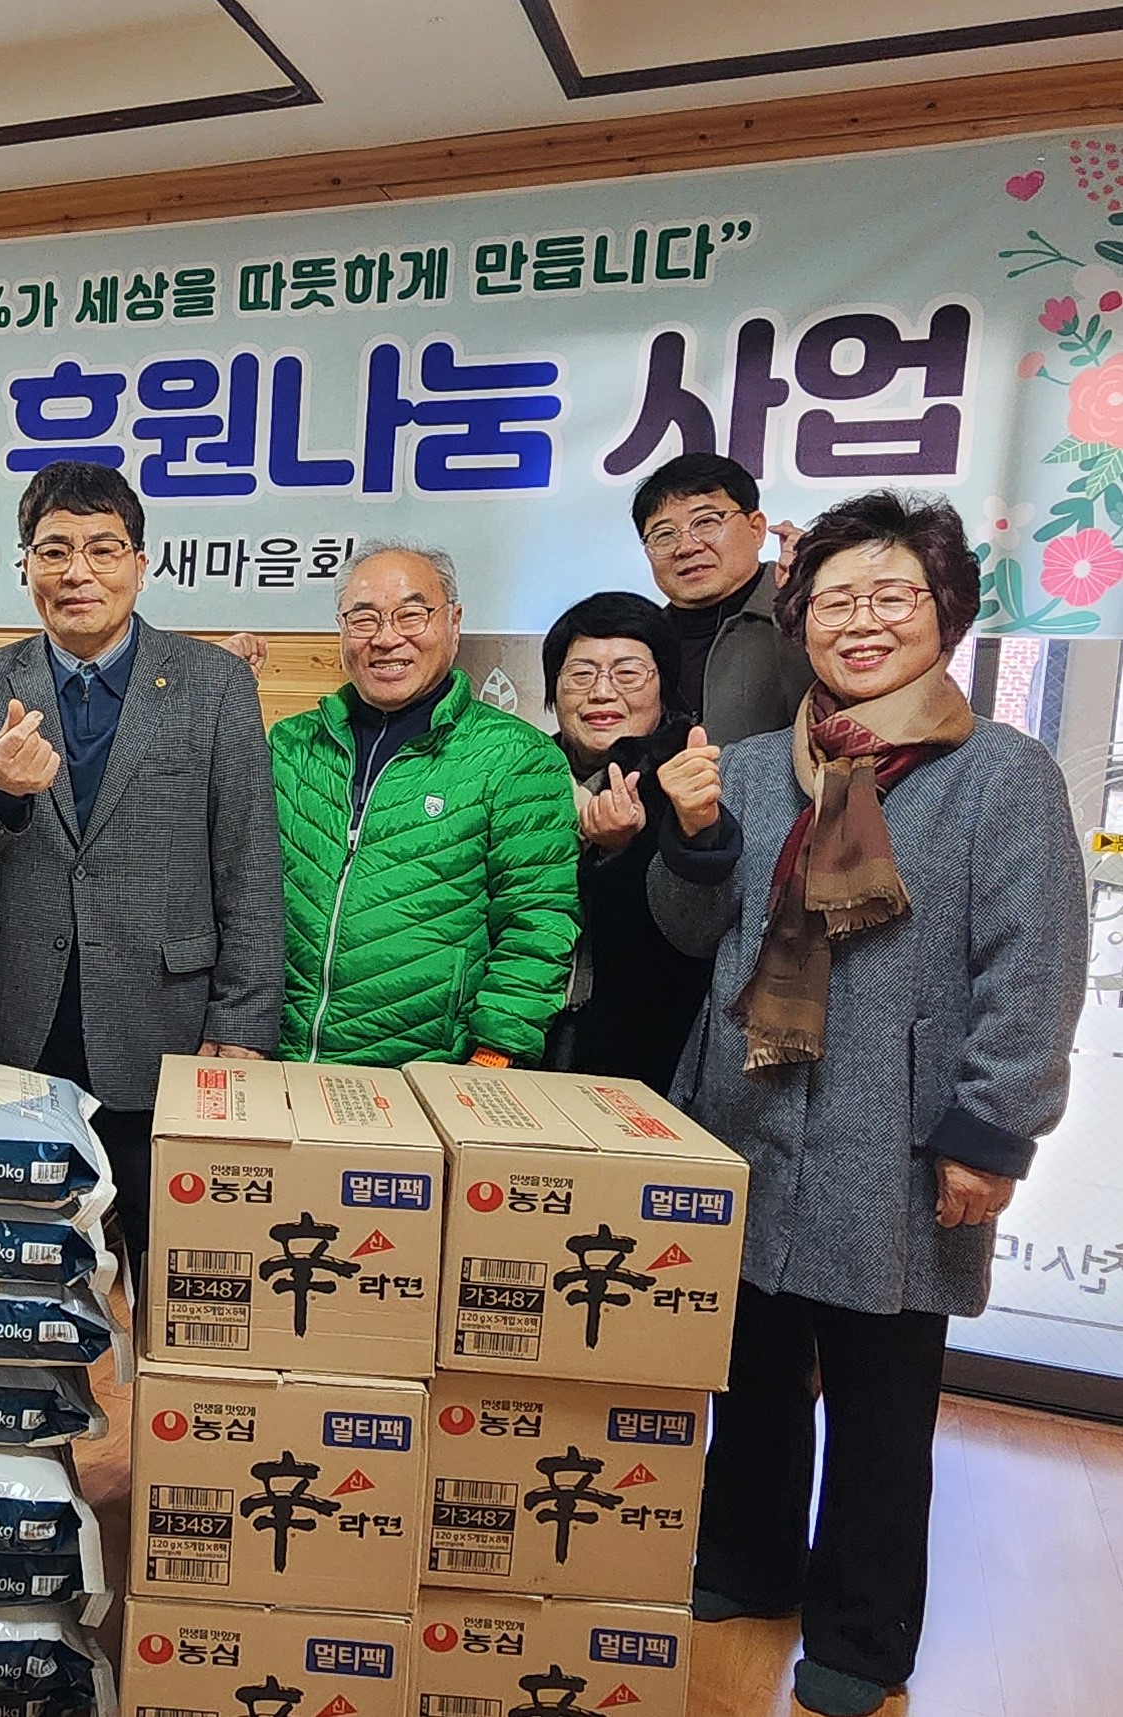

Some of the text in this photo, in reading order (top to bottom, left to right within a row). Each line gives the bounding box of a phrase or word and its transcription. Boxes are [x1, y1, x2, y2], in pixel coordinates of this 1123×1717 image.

[76, 256, 215, 324] 세상을
[239, 247, 448, 312] 따뜻하게
[476, 221, 753, 297] 만듭니다”
[604, 304, 972, 480] 사업
[153, 538, 354, 588] 새마을회
[211, 1165, 274, 1178] 인생을 맛있게
[509, 1174, 574, 1190] 인생을 맛있게
[210, 1177, 272, 1203] 농심
[349, 1176, 424, 1206] 멀티팩
[508, 1187, 572, 1214] 농심
[649, 1190, 725, 1220] 멀티팩
[368, 1233, 384, 1251] 신
[667, 1247, 683, 1264] 신
[259, 1211, 361, 1338] 辛
[358, 1274, 425, 1301] 라면
[553, 1223, 656, 1349] 辛
[173, 1278, 246, 1299] 가3487
[465, 1287, 539, 1309] 가3487
[653, 1288, 720, 1314] 라면
[194, 1402, 256, 1417] 인생을 맛있게
[482, 1400, 544, 1415] 인생을 맛있게
[192, 1415, 255, 1442] 농심
[330, 1417, 404, 1447] 멀티팩
[480, 1413, 542, 1438] 농심
[615, 1413, 689, 1442] 멀티팩
[349, 1472, 366, 1490] 신
[633, 1467, 649, 1483] 신
[240, 1450, 341, 1574] 辛
[438, 1506, 511, 1527] 가3487
[523, 1446, 625, 1565] 辛
[620, 1505, 685, 1530] 라면
[154, 1514, 228, 1535] 가3487
[338, 1512, 404, 1538] 라면
[179, 1627, 241, 1643] 인생을 맛있게
[464, 1617, 525, 1632] 인생을 맛있게
[177, 1640, 240, 1667] 농심
[461, 1629, 523, 1656] 농심
[597, 1634, 671, 1662] 멀티팩
[313, 1644, 386, 1673] 멀티팩
[616, 1687, 632, 1704] 신
